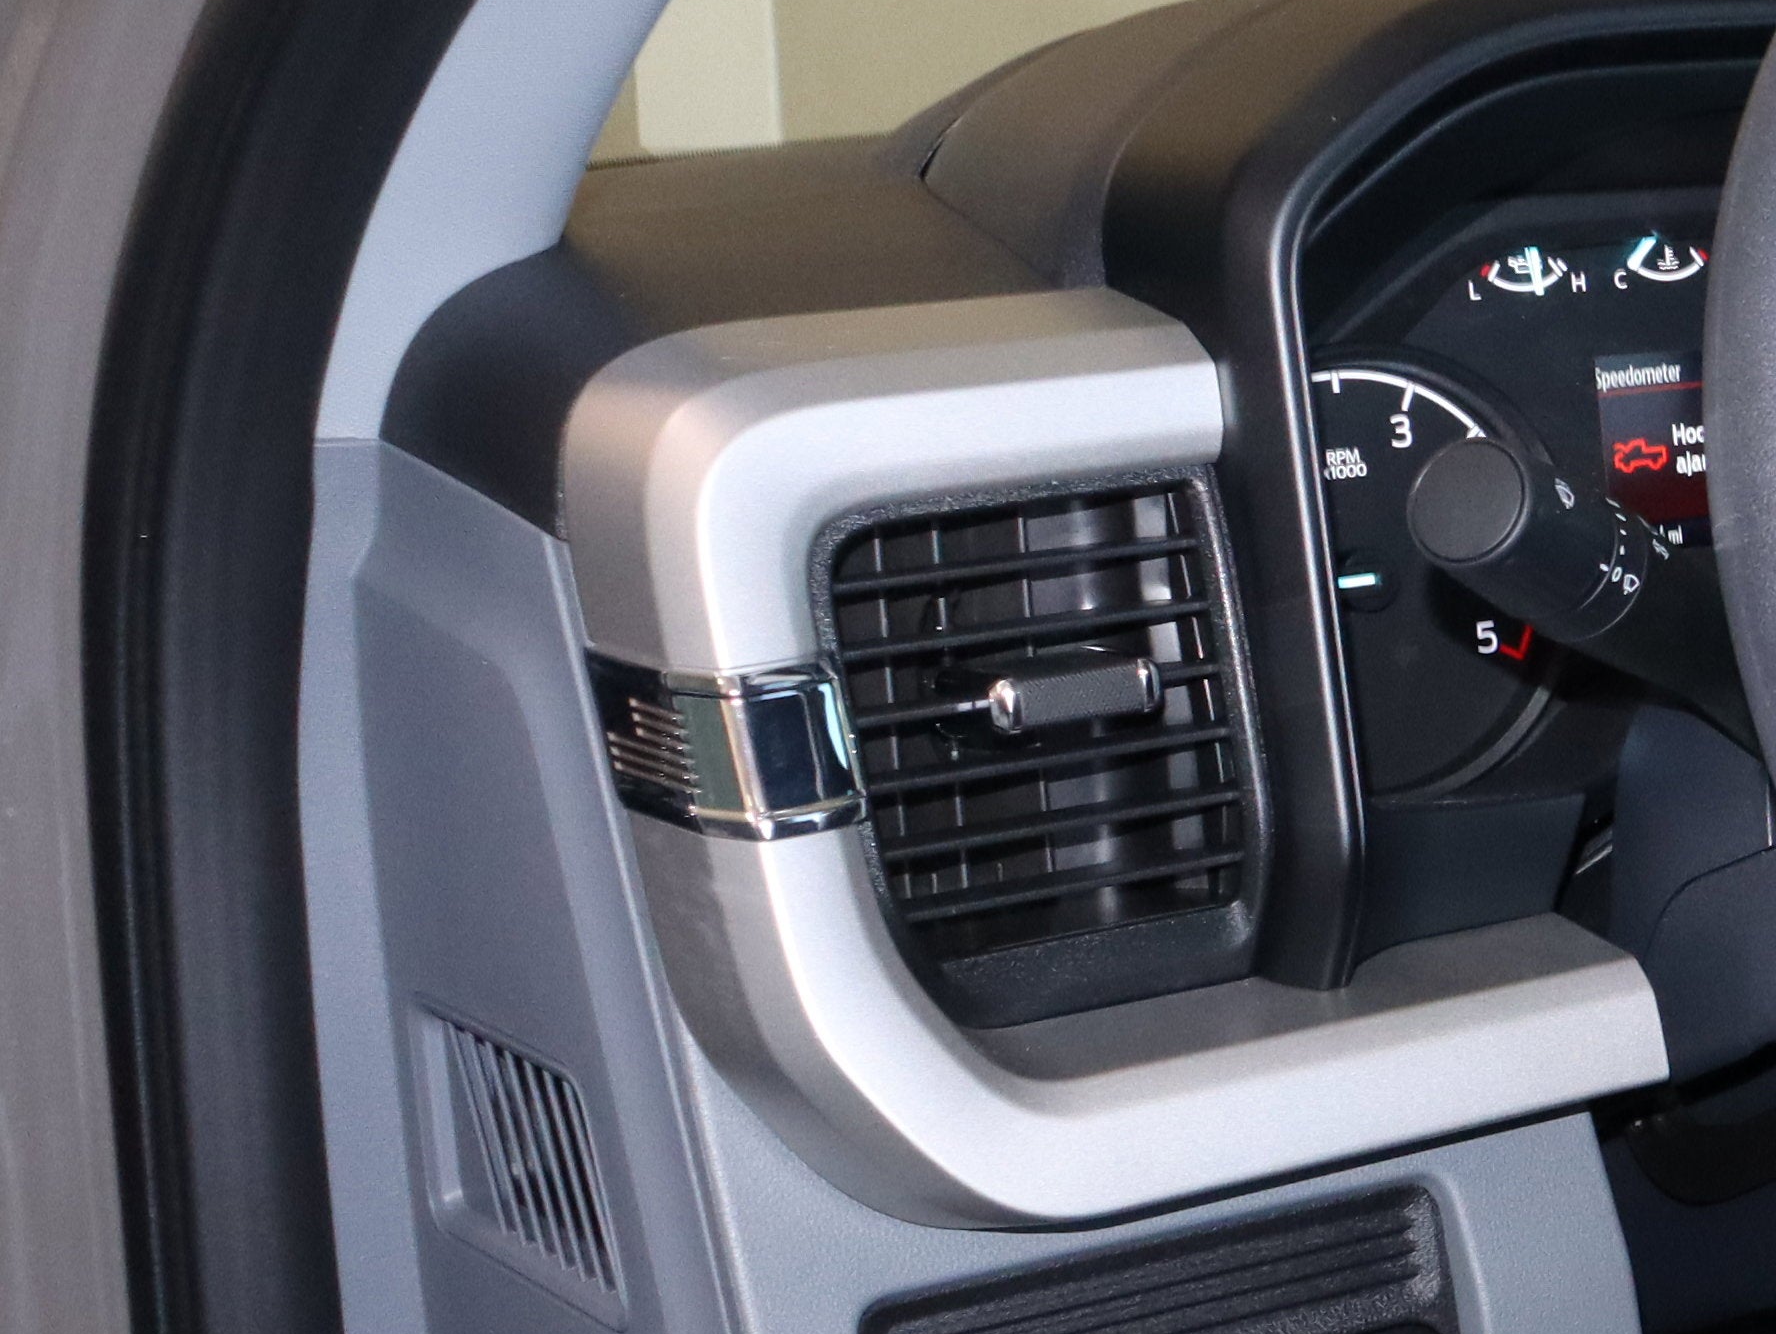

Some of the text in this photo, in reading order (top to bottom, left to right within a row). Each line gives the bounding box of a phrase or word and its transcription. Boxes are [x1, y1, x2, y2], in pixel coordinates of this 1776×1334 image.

[1571, 271, 1587, 293] H
[1613, 268, 1628, 290] C
[1469, 280, 1482, 302] L
[1595, 363, 1681, 393] Speedometer
[1389, 413, 1413, 449] 3
[1671, 422, 1705, 447] Hoo
[1325, 447, 1361, 466] RPM
[1476, 619, 1498, 655] 5
